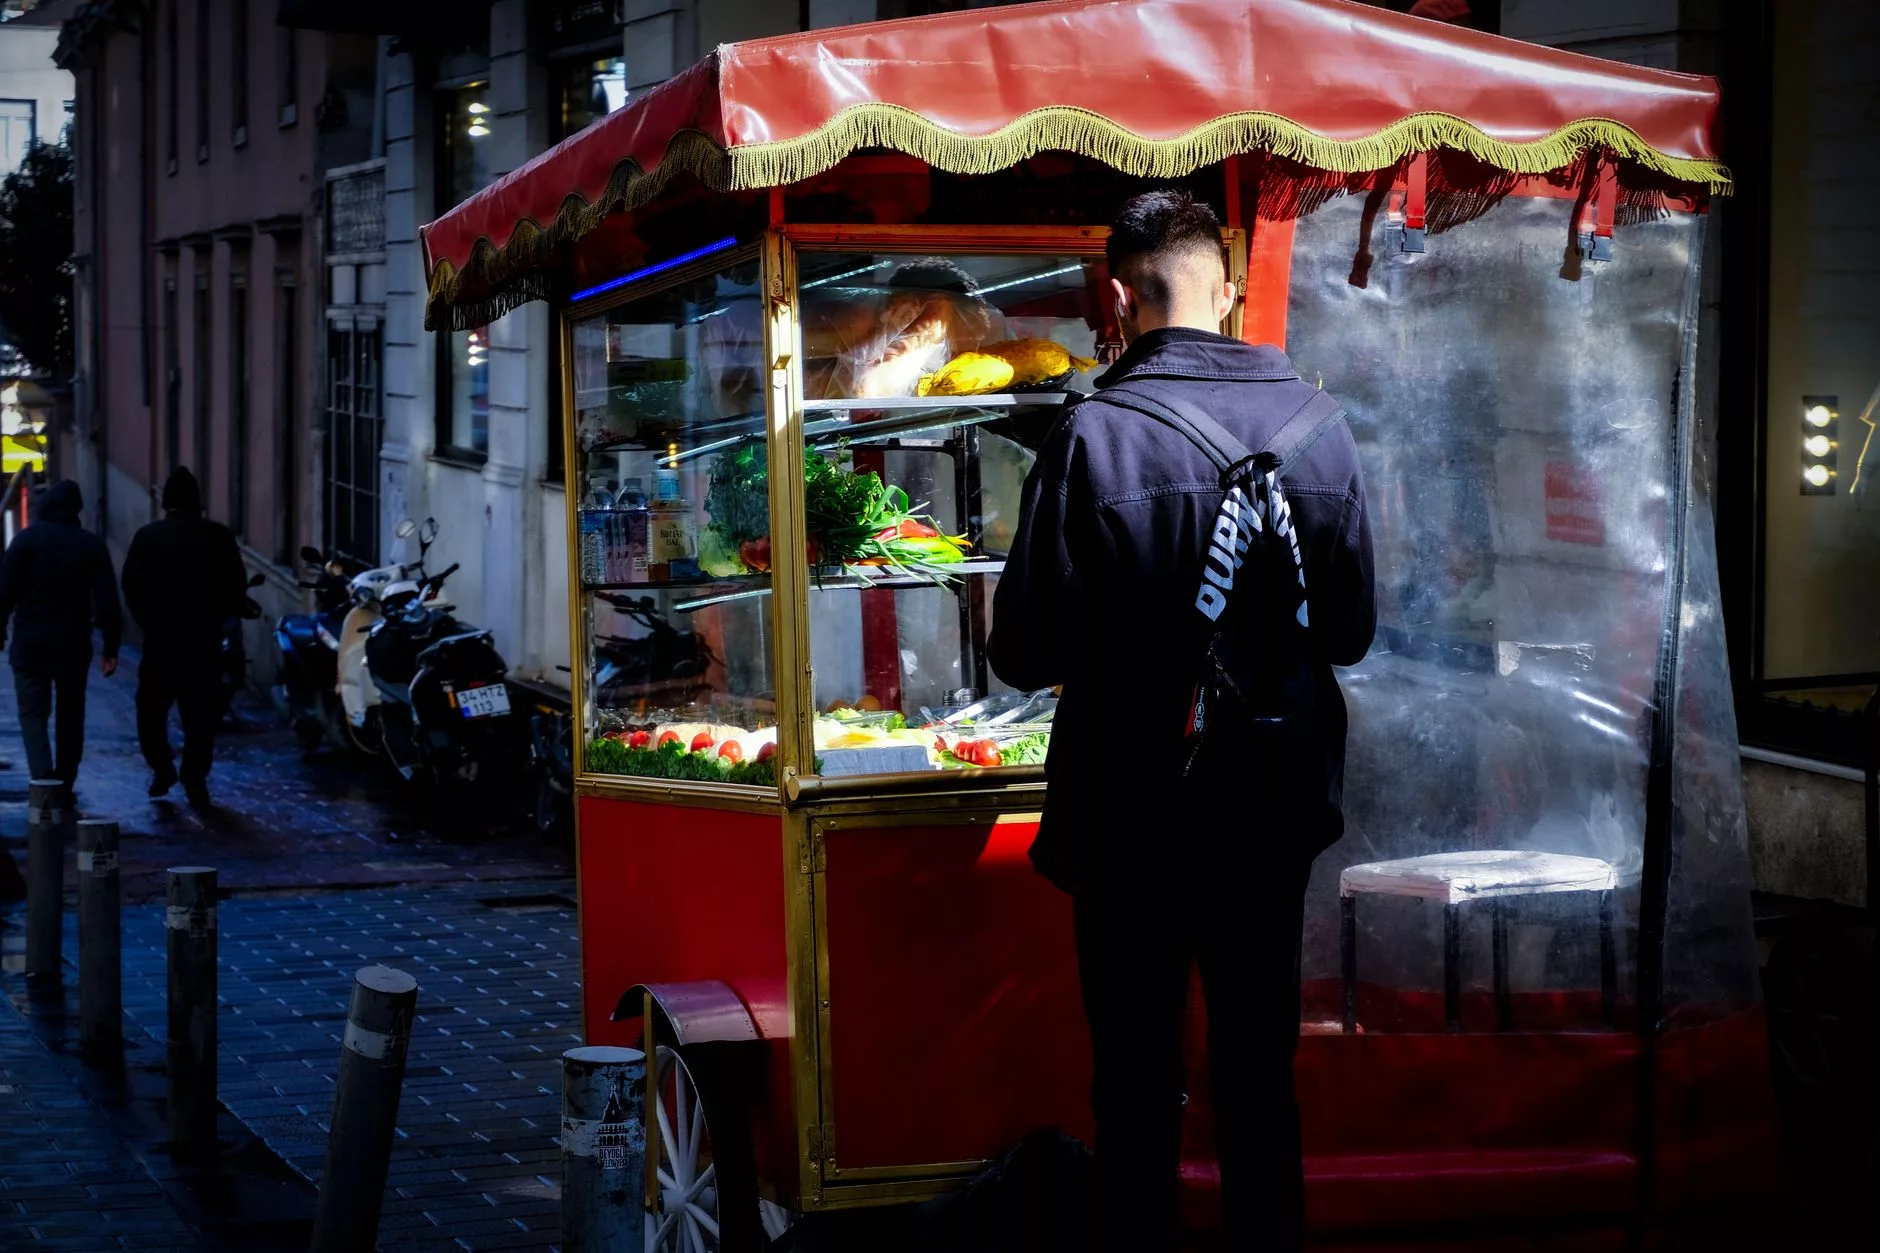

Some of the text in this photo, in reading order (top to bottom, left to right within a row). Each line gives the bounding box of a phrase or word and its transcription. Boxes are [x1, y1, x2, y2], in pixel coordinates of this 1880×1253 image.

[460, 685, 504, 704] 34 HTZ
[473, 700, 494, 714] 113
